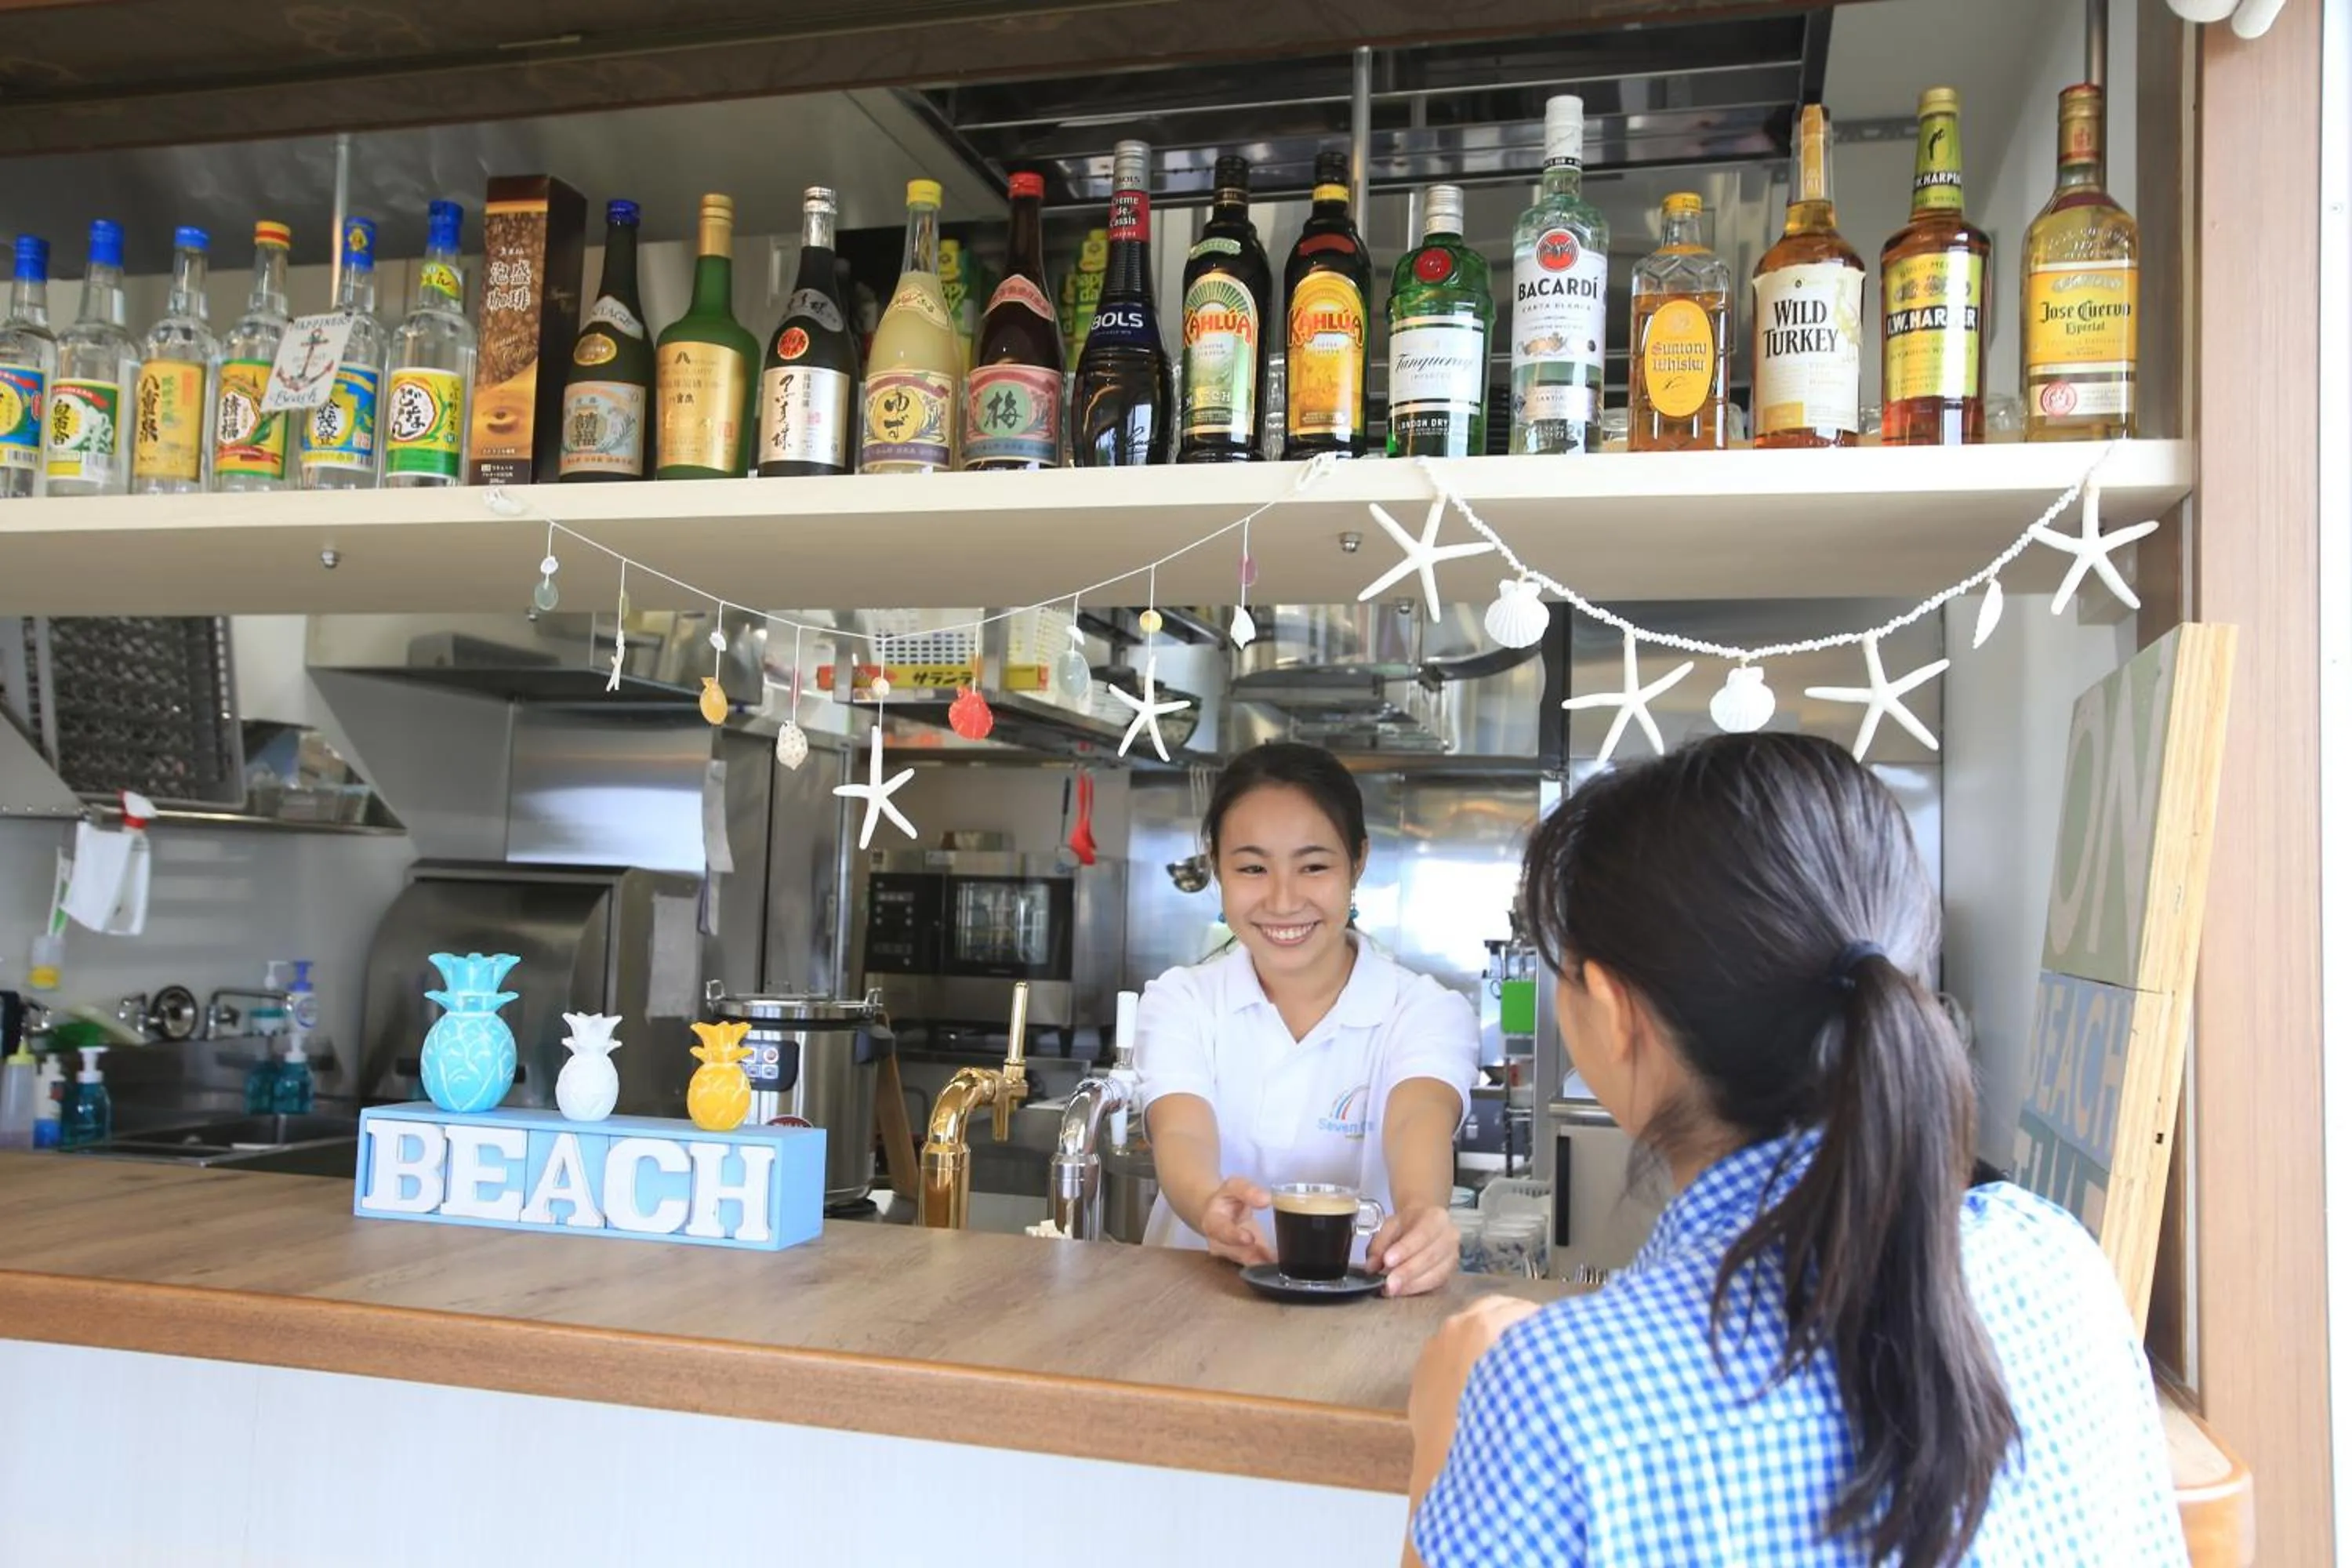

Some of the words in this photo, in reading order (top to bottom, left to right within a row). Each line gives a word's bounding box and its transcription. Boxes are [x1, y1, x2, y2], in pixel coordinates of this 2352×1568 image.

[489, 260, 532, 285] 泡盛
[486, 286, 531, 311] 珈琲
[1518, 277, 1598, 302] BACARDÍ
[1091, 312, 1144, 330] BOLS
[1773, 298, 1828, 328] WILD
[1887, 303, 1976, 336] I.W.HARR
[2040, 300, 2075, 324] Jose
[2078, 299, 2131, 321] Cuervo
[1184, 308, 1254, 348] KAHLÚA
[1289, 308, 1363, 350] KAHLÚA
[1763, 326, 1838, 358] TURKEY
[1396, 354, 1473, 372] Tanqueray
[1652, 341, 1707, 356] Suntory
[1652, 357, 1704, 374] Whisky
[884, 392, 910, 441] ゆず
[984, 390, 1023, 429] 梅
[1431, 418, 1450, 428] DRY
[2047, 631, 2178, 980] ON
[2021, 982, 2132, 1157] BEACH
[361, 1118, 776, 1242] BEACH
